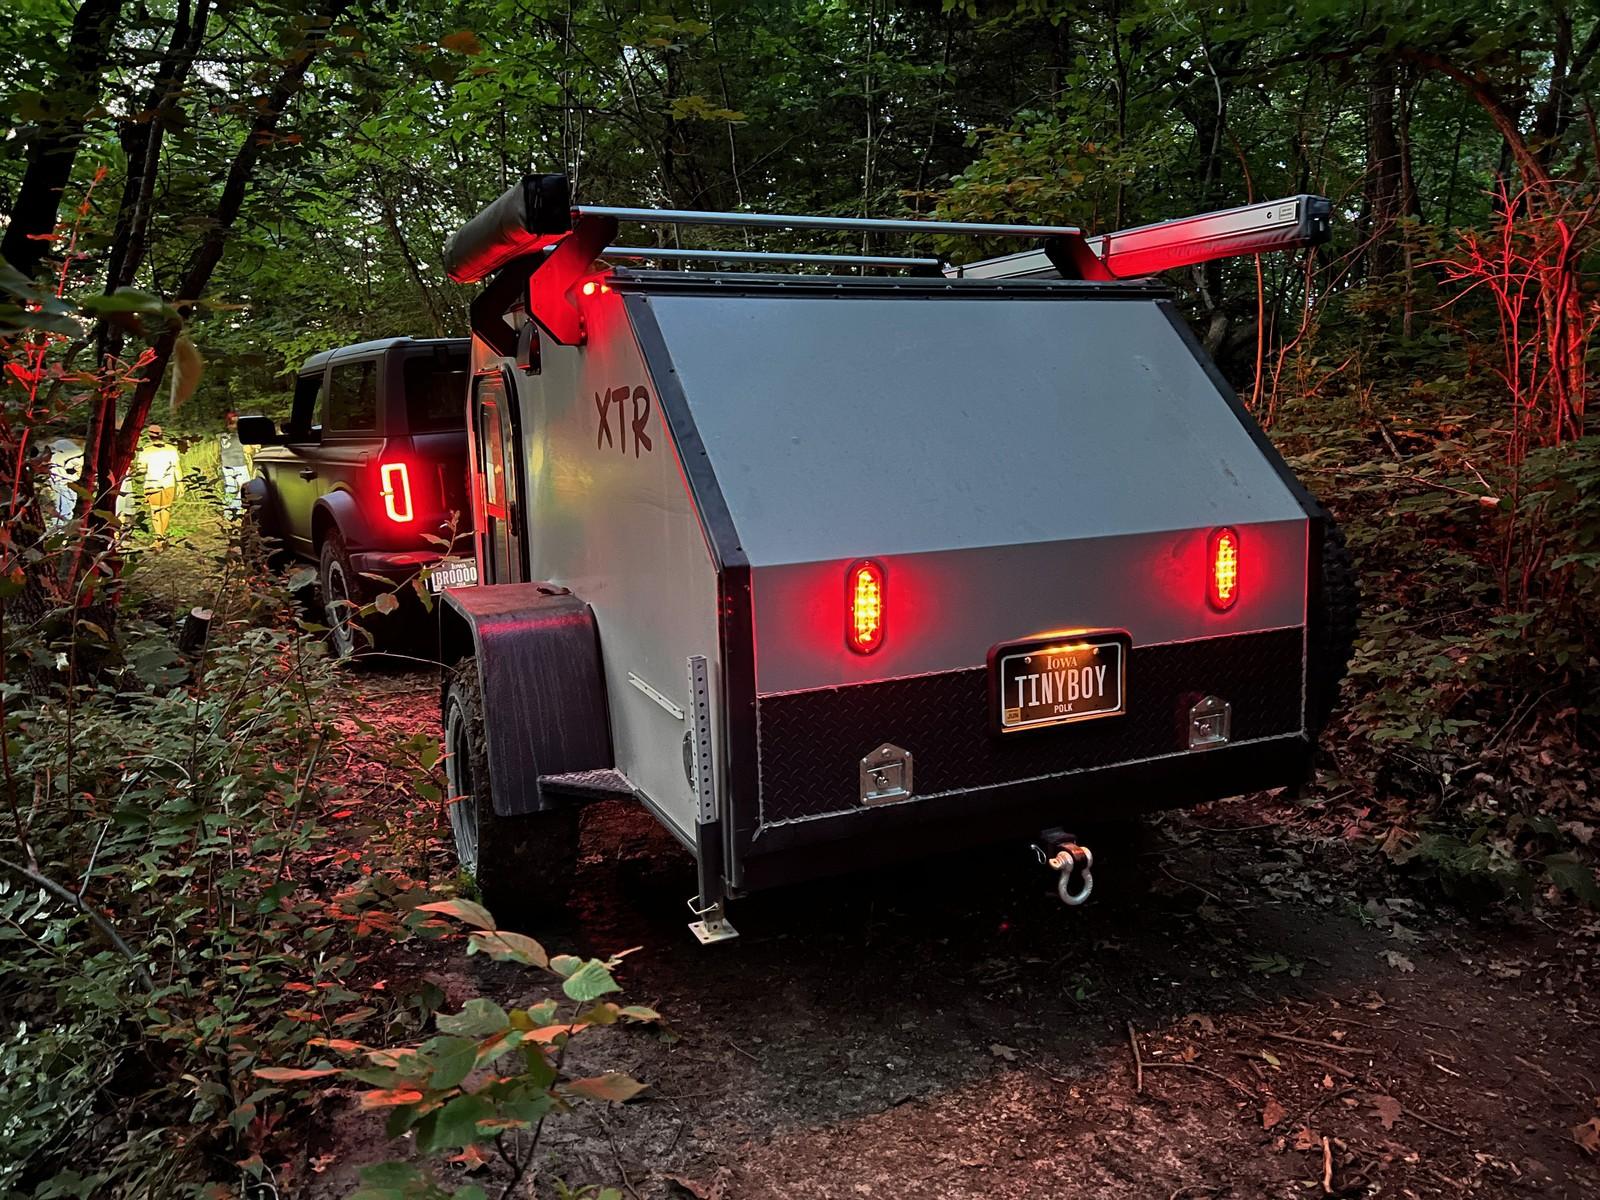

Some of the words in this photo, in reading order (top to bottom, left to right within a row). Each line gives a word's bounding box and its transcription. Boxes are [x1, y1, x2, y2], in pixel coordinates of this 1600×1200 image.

[595, 385, 652, 459] XTR
[1014, 665, 1106, 708] TINYBOY
[1054, 703, 1073, 714] POLK
